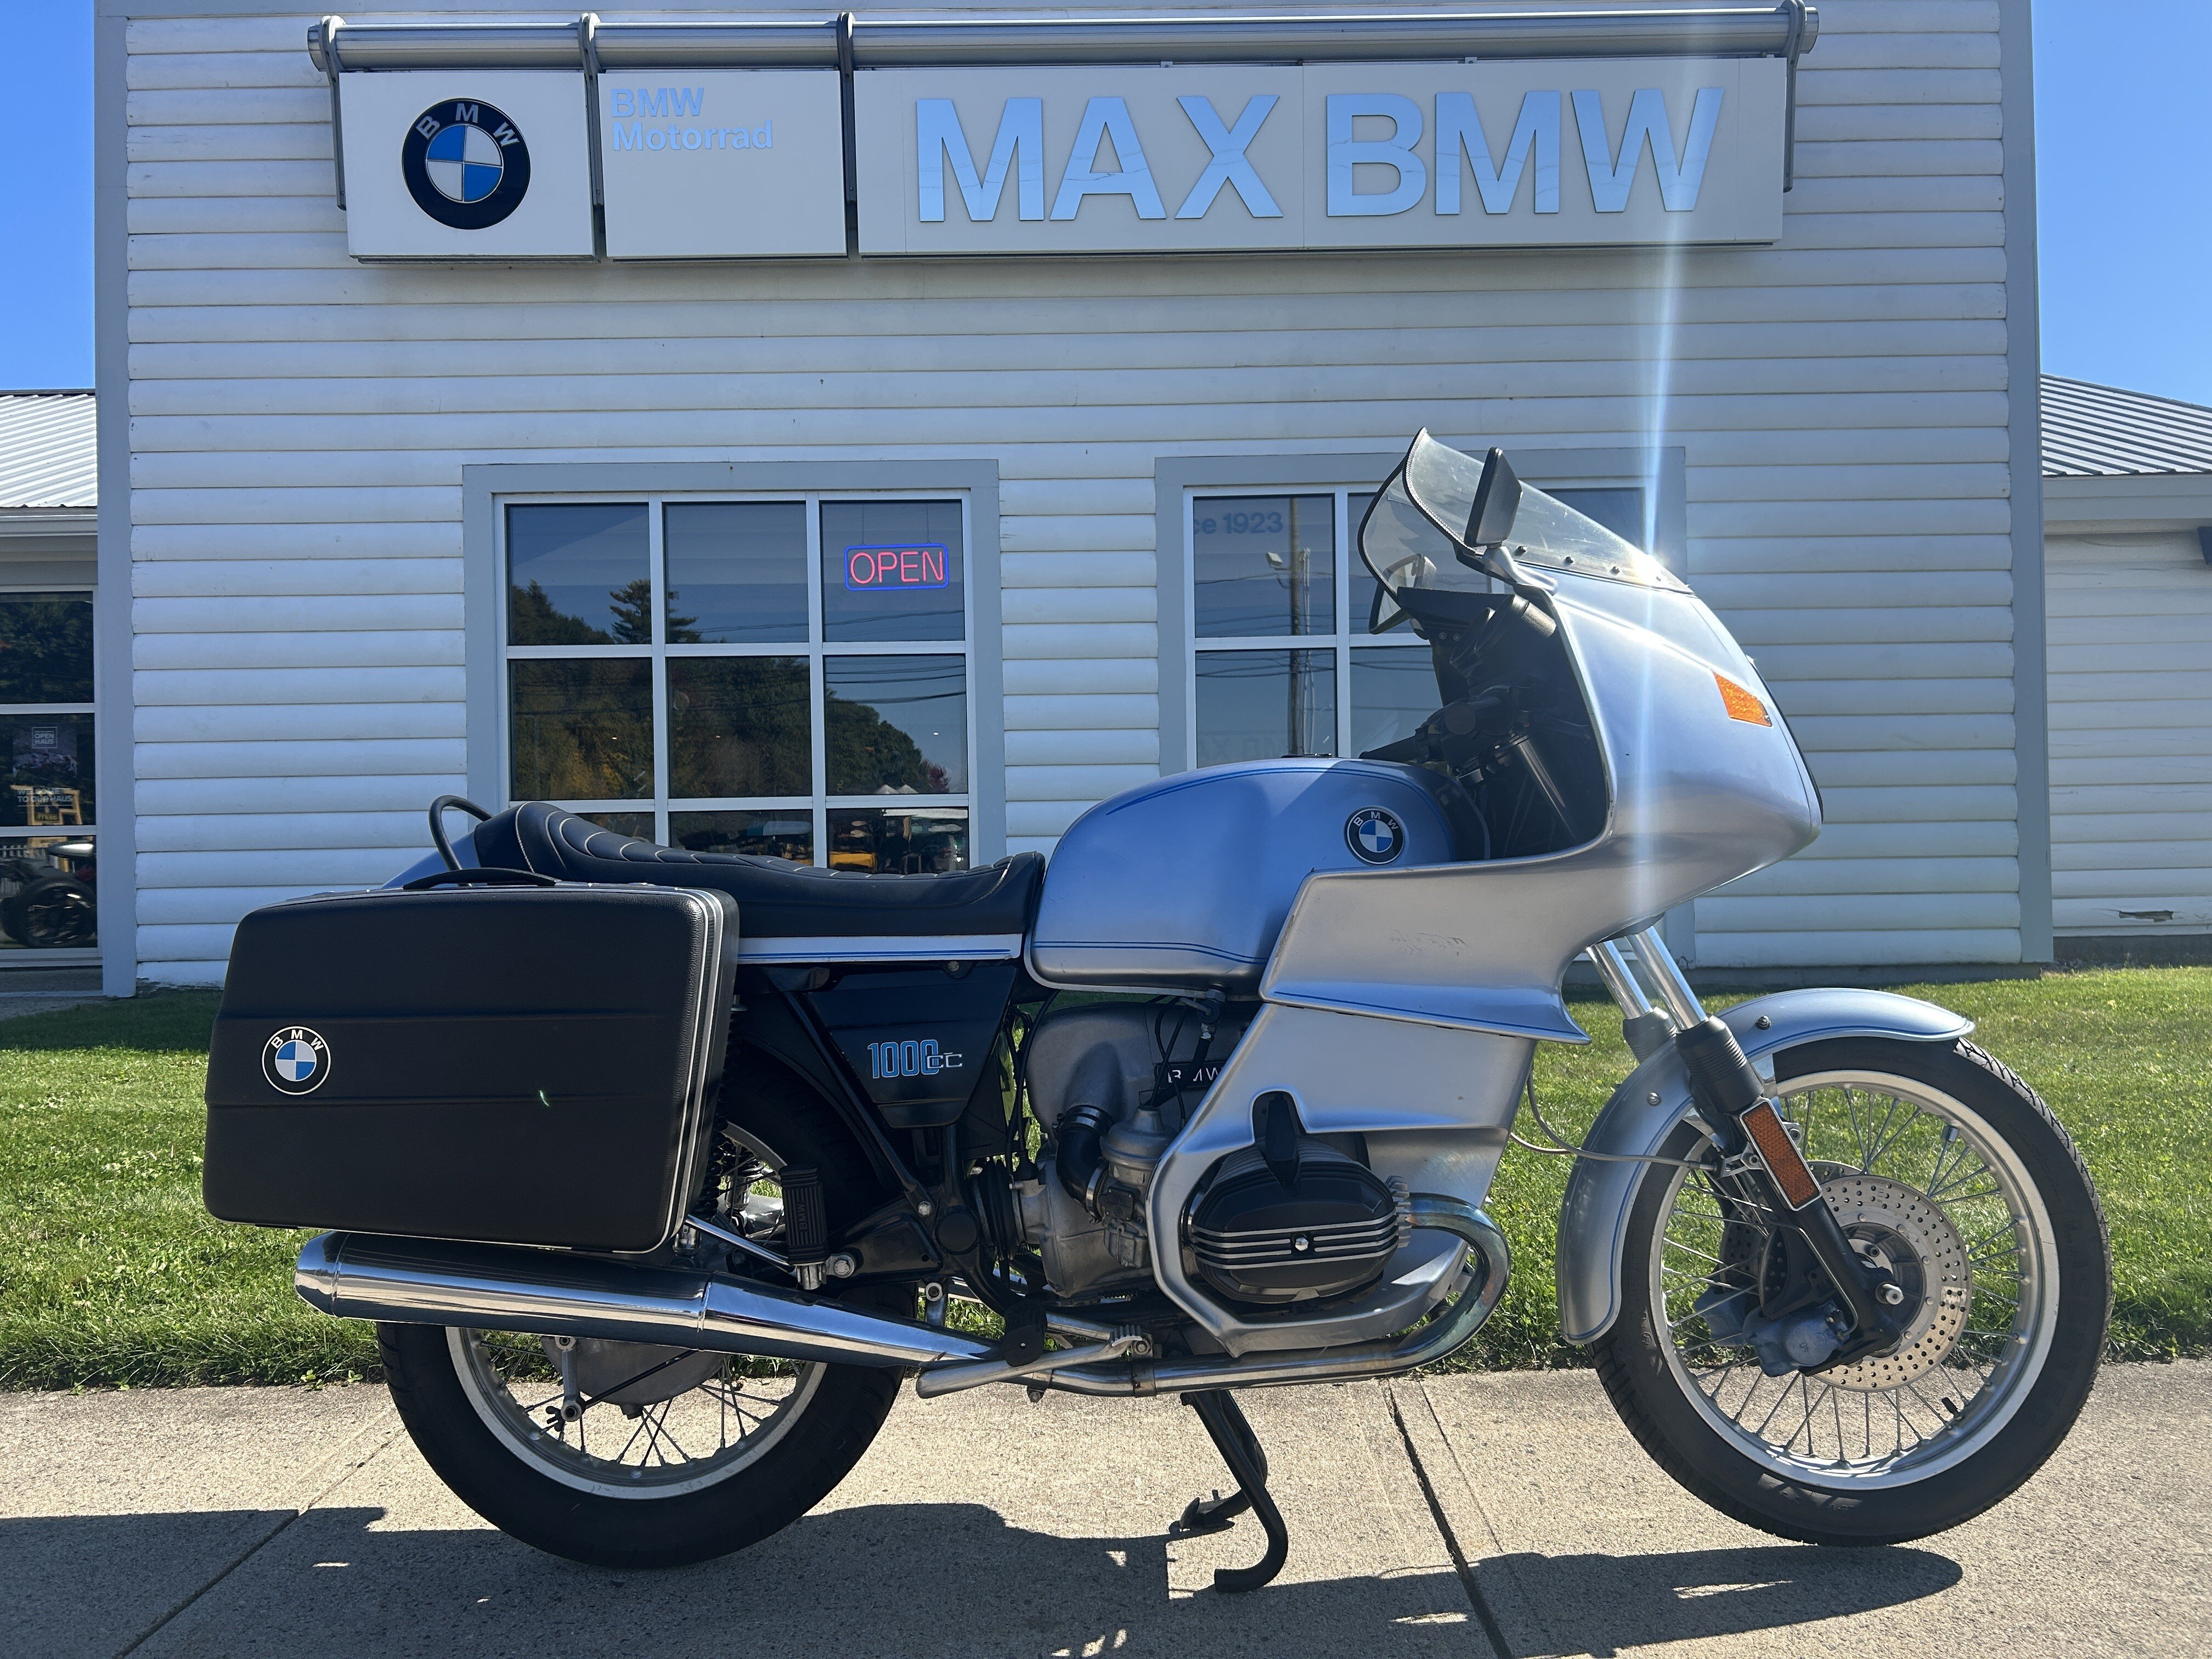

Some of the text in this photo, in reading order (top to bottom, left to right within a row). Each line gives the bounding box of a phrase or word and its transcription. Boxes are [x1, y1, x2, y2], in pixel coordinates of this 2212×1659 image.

[610, 87, 705, 118] BMW
[416, 102, 521, 149] BMW
[612, 119, 774, 151] Motorrad
[915, 86, 1726, 222] MAX BMW
[1221, 511, 1283, 534] 1923
[850, 551, 944, 584] OPEN
[1353, 811, 1400, 831] BMW
[270, 1029, 324, 1051] BMW
[797, 1203, 808, 1230] BMW
